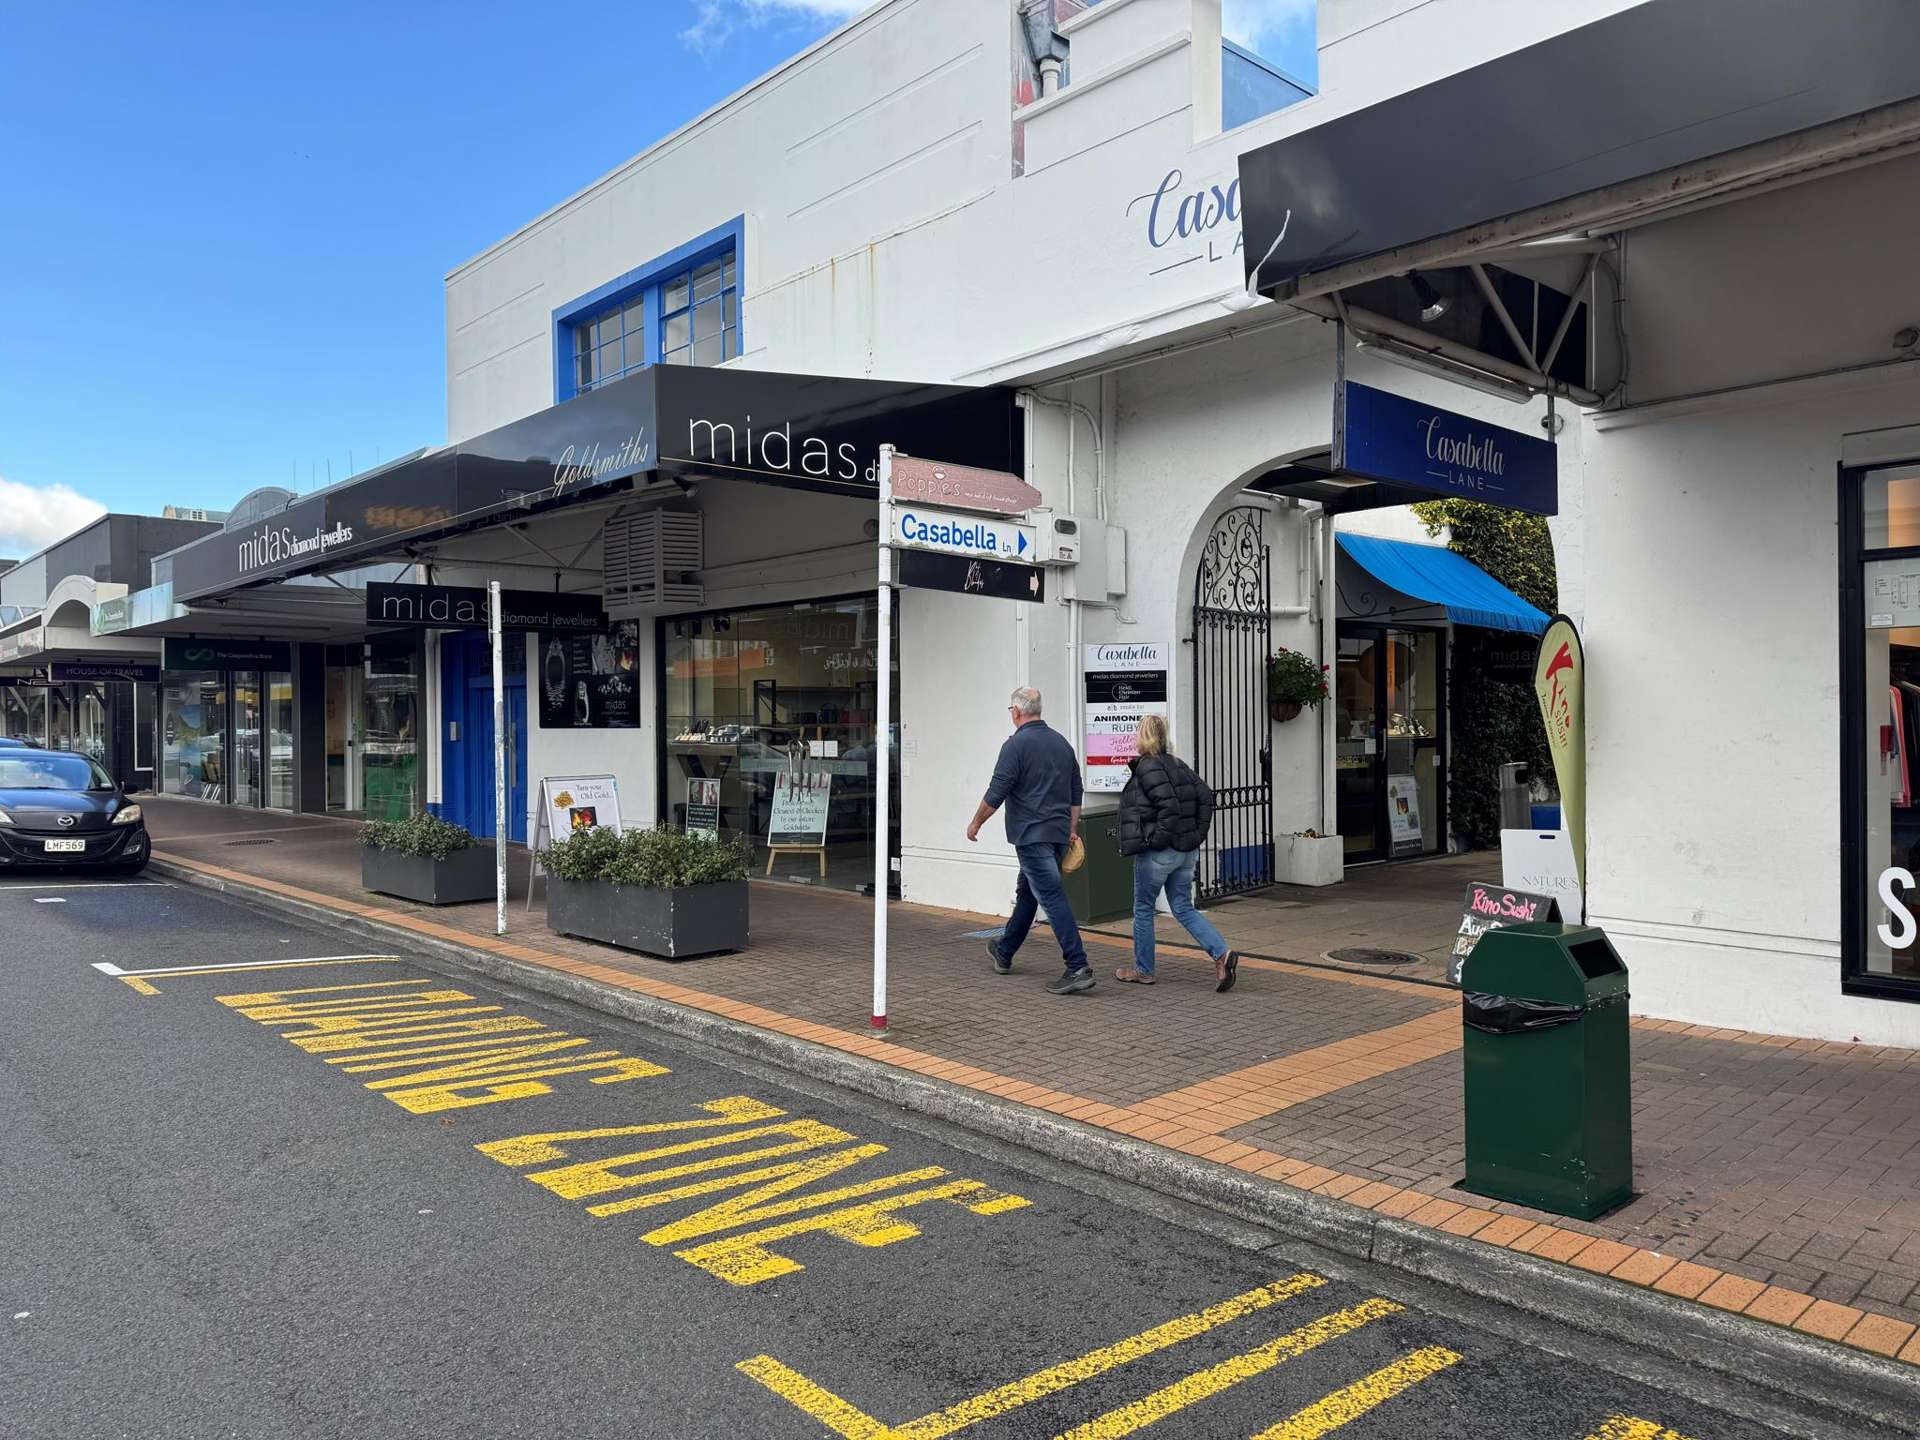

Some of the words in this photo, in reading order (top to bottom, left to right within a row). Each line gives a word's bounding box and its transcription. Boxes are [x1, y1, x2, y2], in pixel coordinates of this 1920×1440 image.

[552, 425, 649, 498] Goldsmiths
[689, 413, 857, 481] midas
[1416, 414, 1505, 477] Casabella
[1448, 473, 1485, 491] LANE
[238, 524, 291, 573] midas
[290, 528, 320, 557] diamond
[320, 521, 353, 554] jewellers
[901, 512, 997, 552] Casabella
[1002, 542, 1012, 554] Ln
[552, 612, 598, 629] jewellers
[65, 667, 97, 676] HOUSE
[114, 667, 145, 677] TRAVEL
[1097, 644, 1158, 660] Casabella
[1109, 671, 1134, 679] diamond
[1134, 671, 1159, 680] jewellers
[1554, 710, 1568, 749] SUSHI
[46, 841, 84, 850] LMF569
[1471, 887, 1501, 916] Kino
[1500, 893, 1537, 921] Sushi
[1877, 865, 1917, 950] S
[214, 978, 673, 1115] LOADING
[472, 1096, 1034, 1286] ZONE
